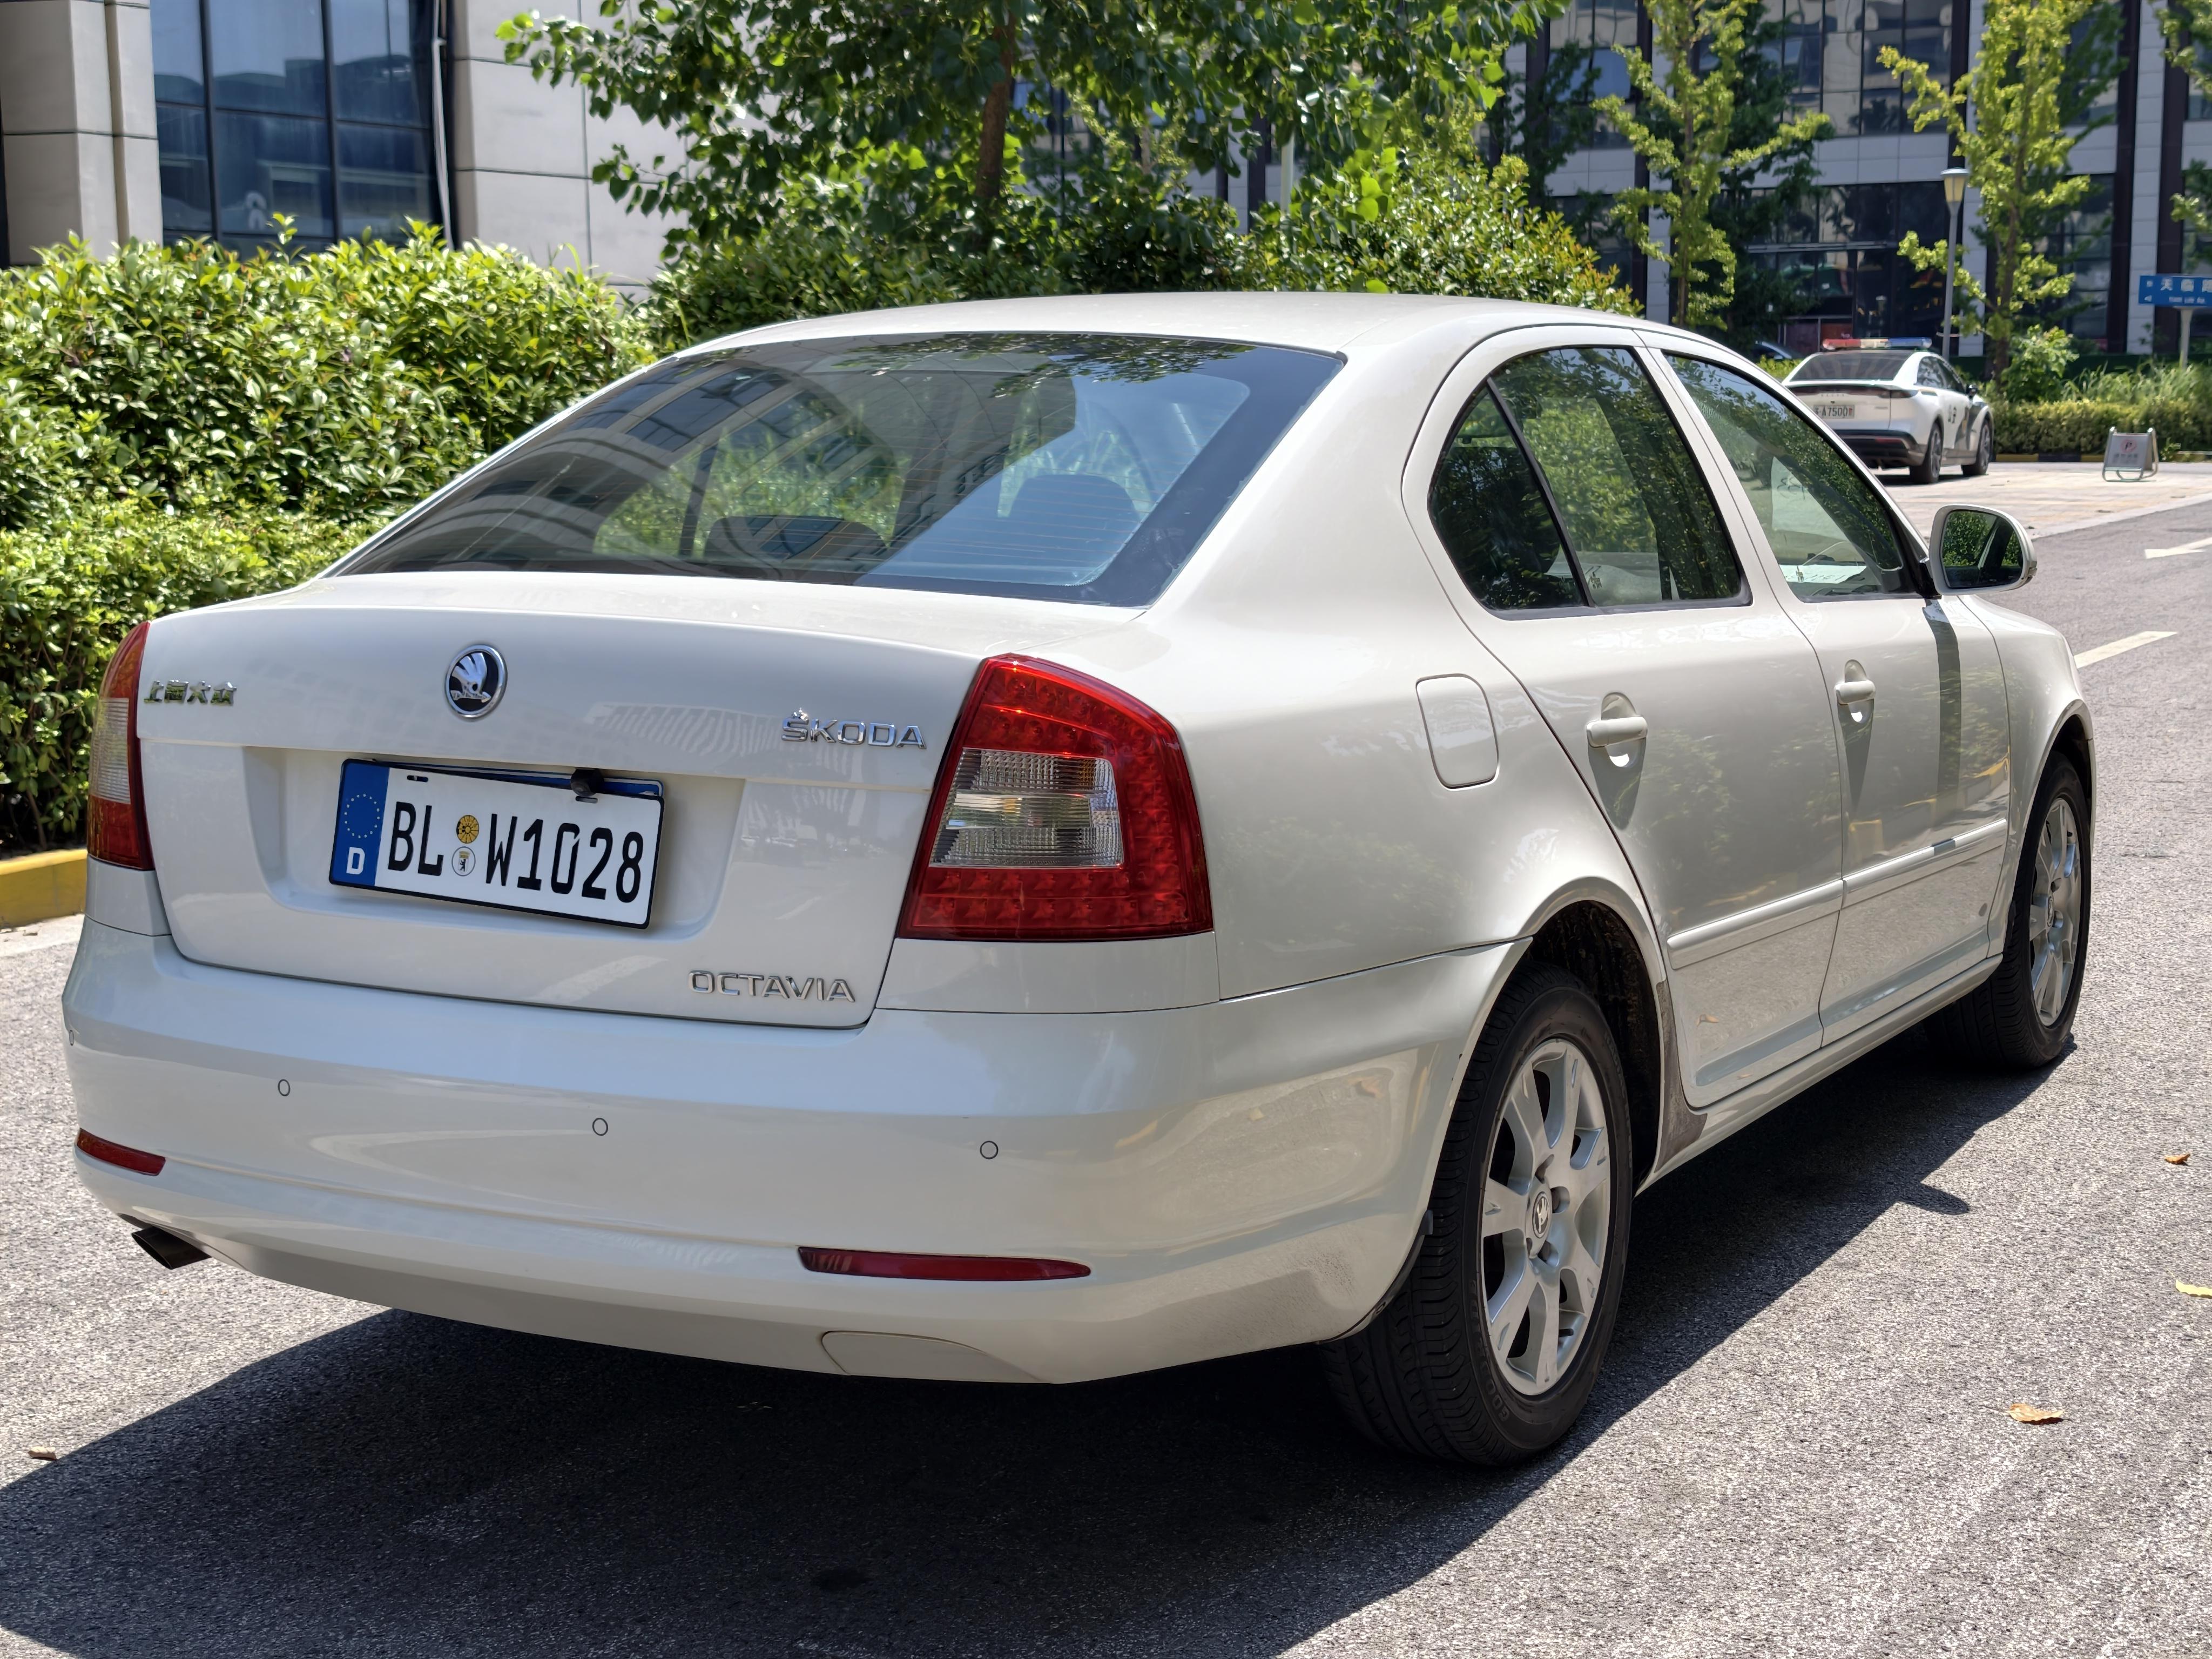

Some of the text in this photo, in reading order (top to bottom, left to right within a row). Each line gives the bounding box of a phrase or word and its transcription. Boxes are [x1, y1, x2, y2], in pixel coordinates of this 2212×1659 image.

[781, 708, 927, 750] ŠKODA
[346, 846, 366, 875] D
[387, 801, 644, 904] BL W1028
[688, 970, 855, 1003] OCTAVIA
